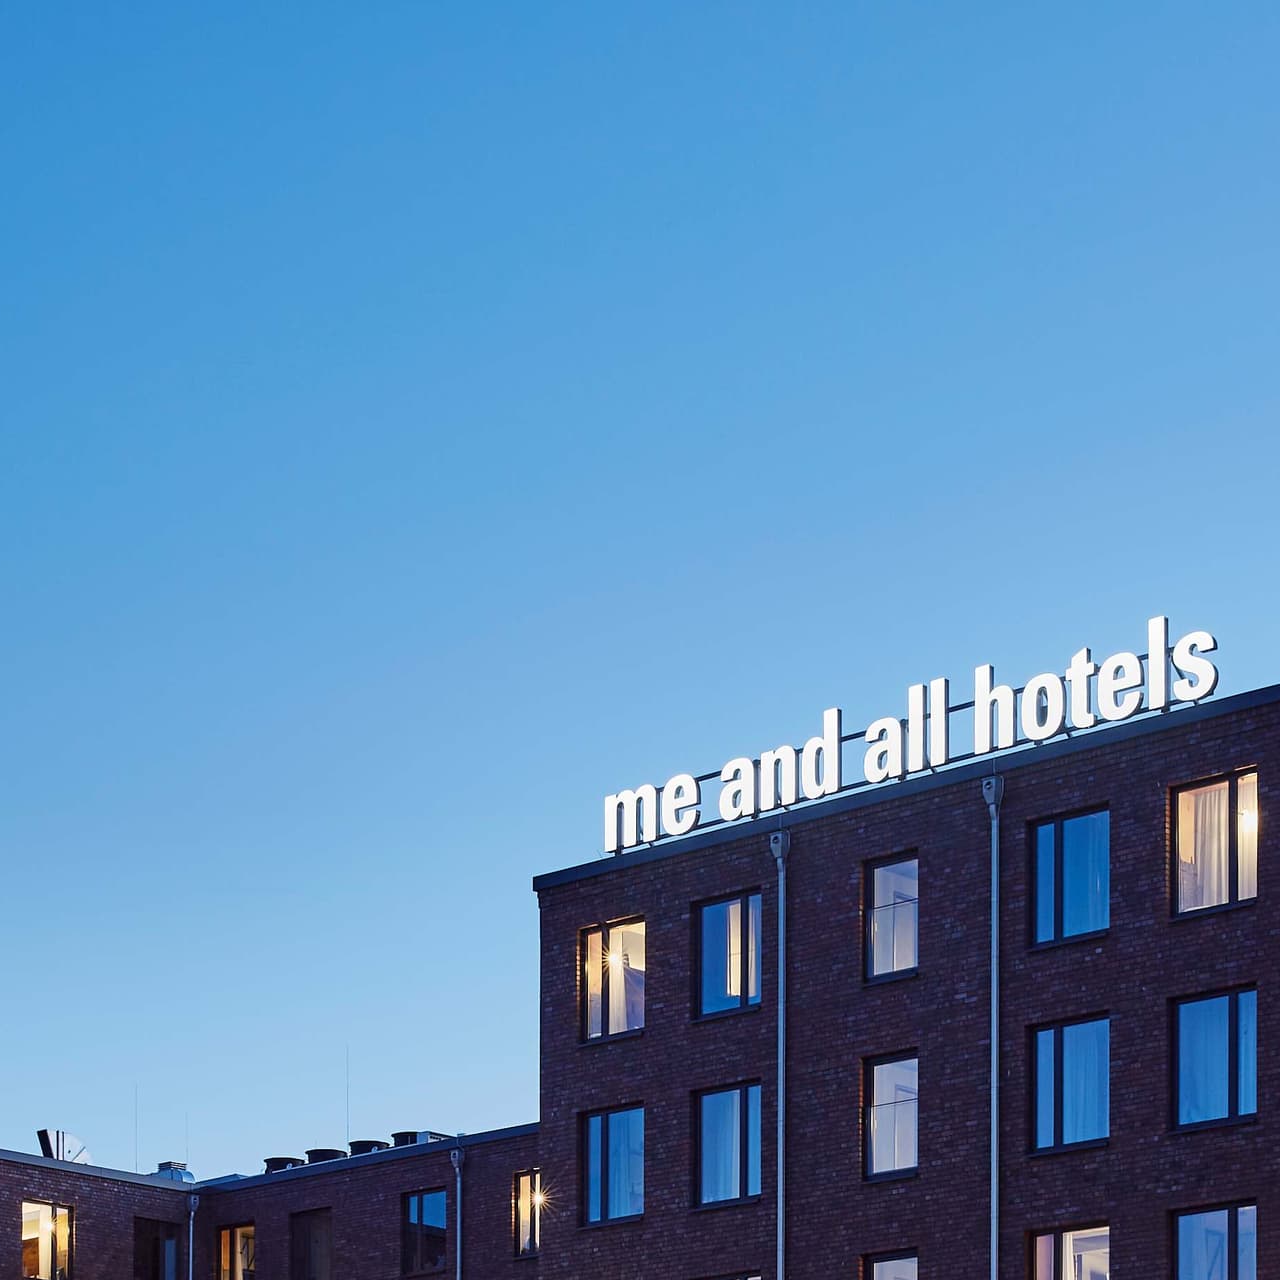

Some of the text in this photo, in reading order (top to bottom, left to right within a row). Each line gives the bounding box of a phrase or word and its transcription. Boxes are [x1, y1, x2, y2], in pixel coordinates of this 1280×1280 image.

[604, 615, 1218, 852] me and all hotels
